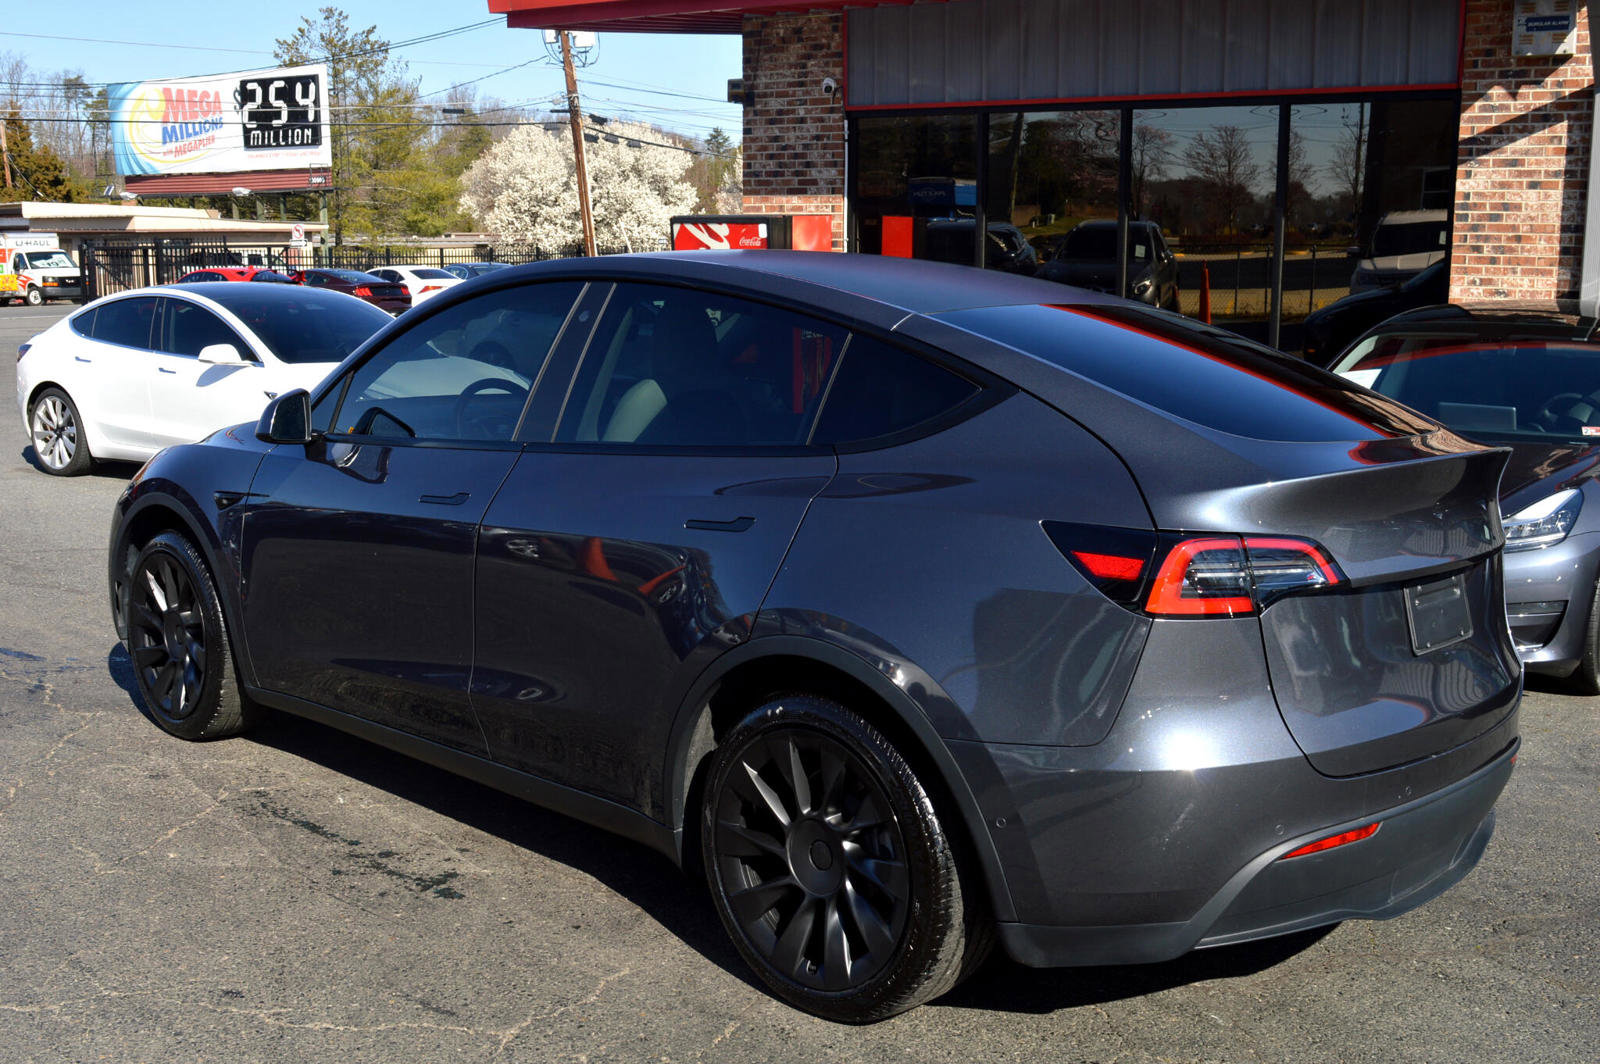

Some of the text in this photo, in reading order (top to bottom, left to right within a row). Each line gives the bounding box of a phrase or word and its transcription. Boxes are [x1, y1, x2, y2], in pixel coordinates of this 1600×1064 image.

[162, 87, 223, 123] MEGA
[162, 117, 223, 145] MILLIONS
[250, 129, 312, 146] MILLION
